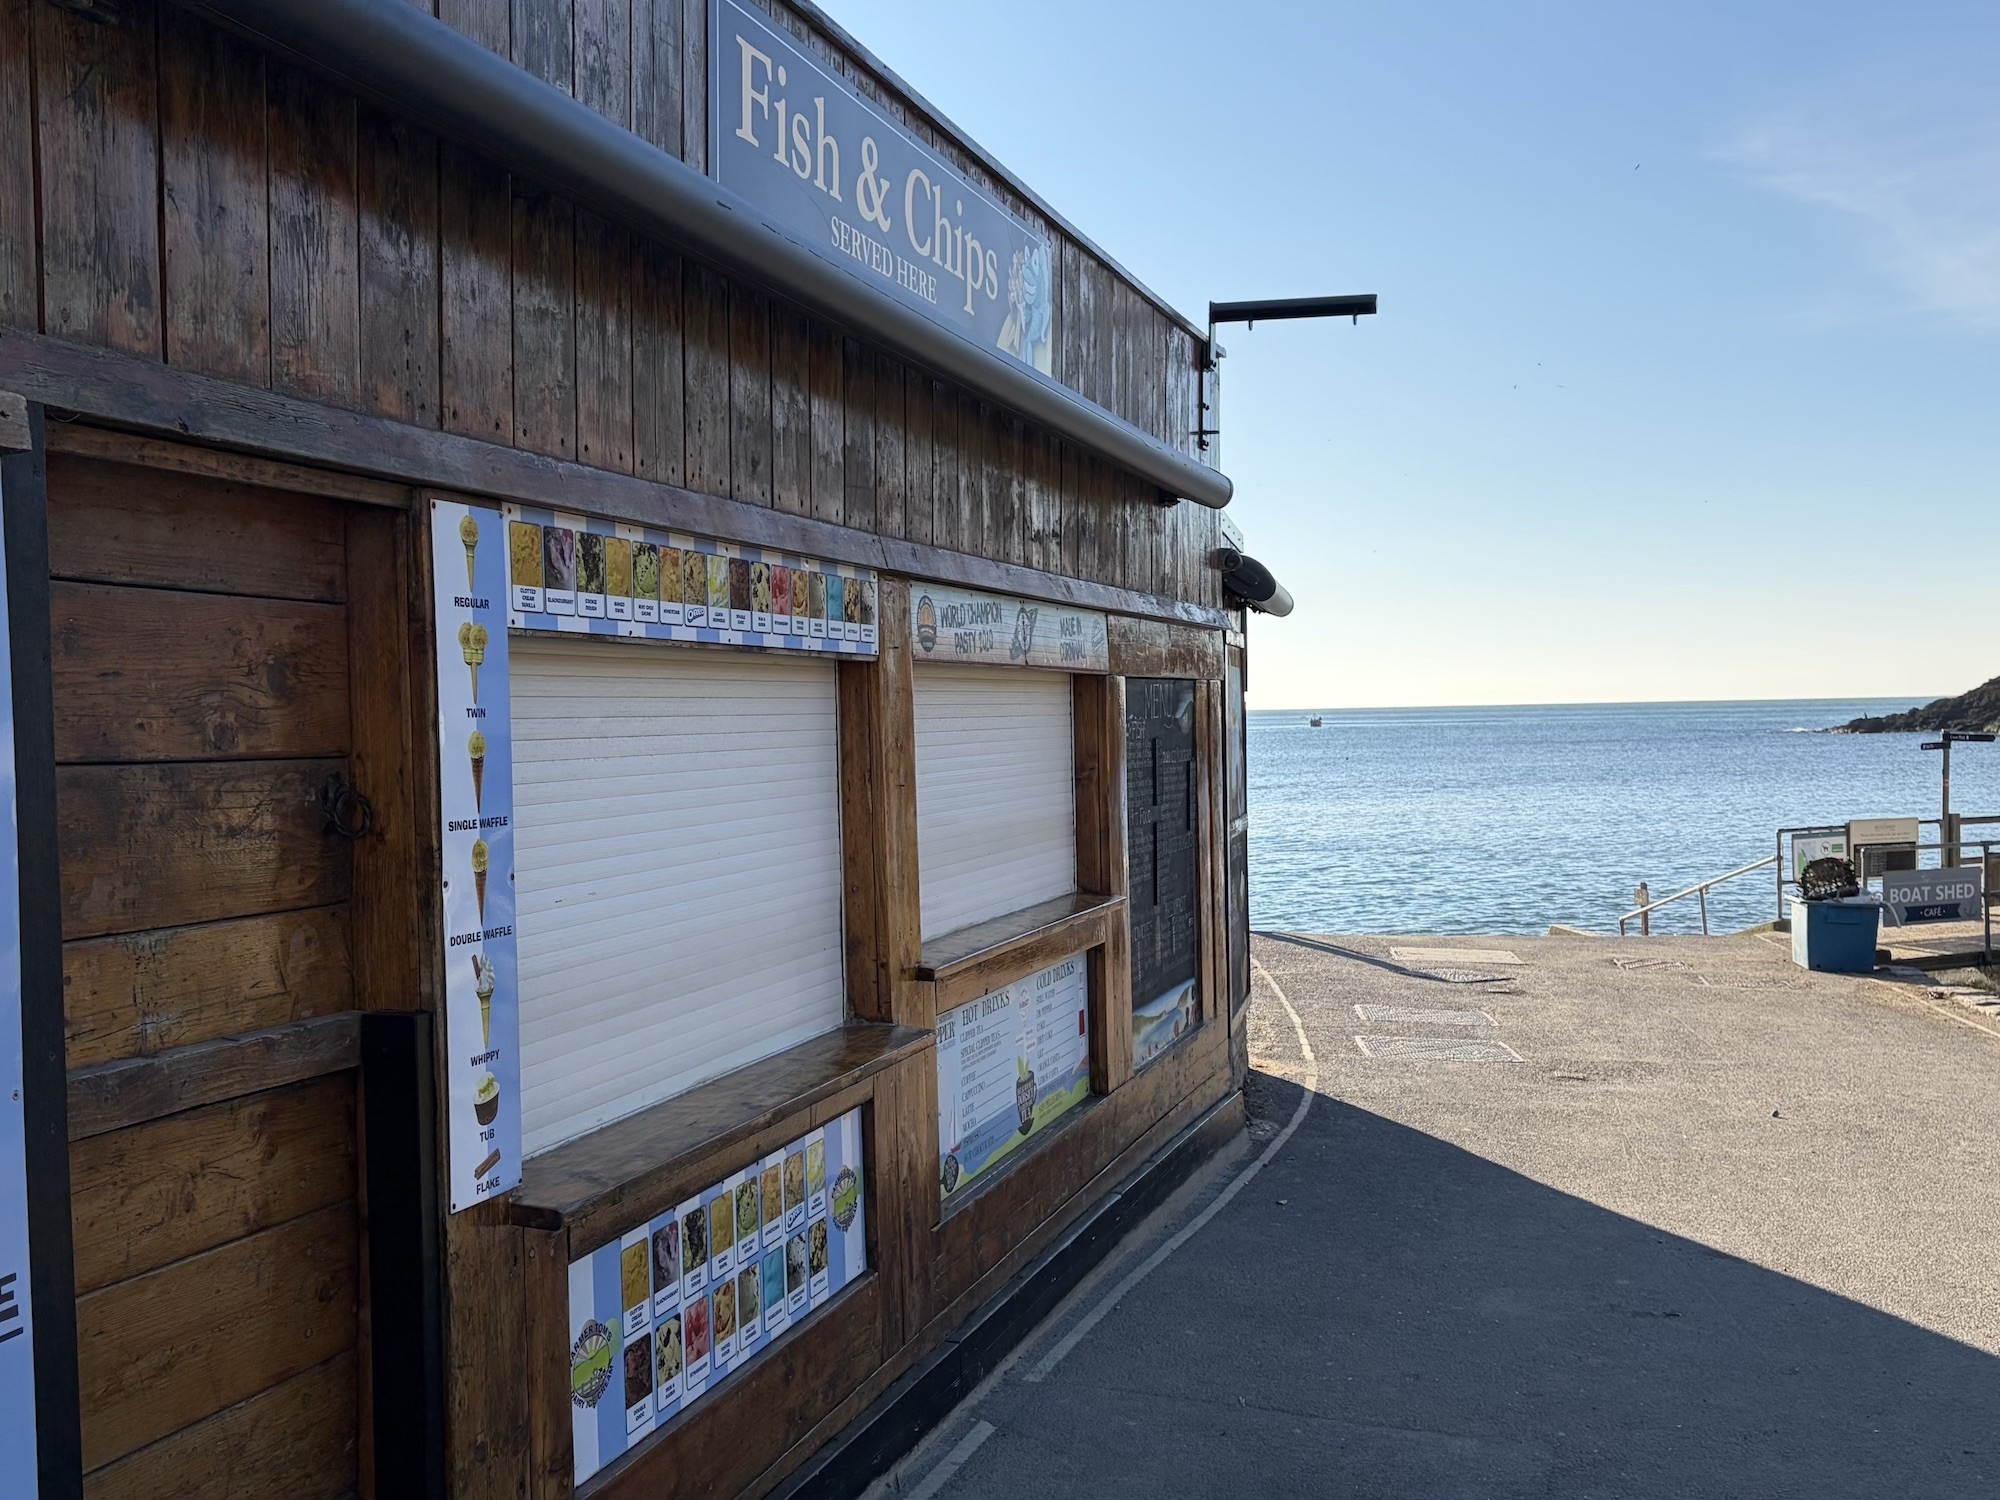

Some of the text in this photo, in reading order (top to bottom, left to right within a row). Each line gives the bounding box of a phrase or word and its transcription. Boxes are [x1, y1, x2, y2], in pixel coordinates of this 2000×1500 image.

[736, 34, 998, 316] Fish & Chips
[831, 216, 937, 304] SERVED HERE
[454, 596, 490, 610] REGULAR
[687, 607, 705, 623] OREO
[940, 602, 1002, 628] WORLD CHAMPION
[954, 631, 976, 655] PASTY
[1144, 684, 1174, 719] MENU
[466, 708, 486, 718] TWIN
[448, 816, 508, 832] SINGLE WAFFLE
[1890, 884, 1975, 904] BOAT SHED
[1924, 906, 1942, 917] CAFÉ
[450, 926, 512, 947] DOUBLE WAFFLE
[1036, 960, 1074, 990] COLD DRINKS
[962, 1004, 978, 1026] HOT
[982, 991, 1010, 1017] DRINKS
[470, 1048, 500, 1067] WHIPPY
[479, 1128, 495, 1142] TUB
[476, 1176, 500, 1194] FLAKE
